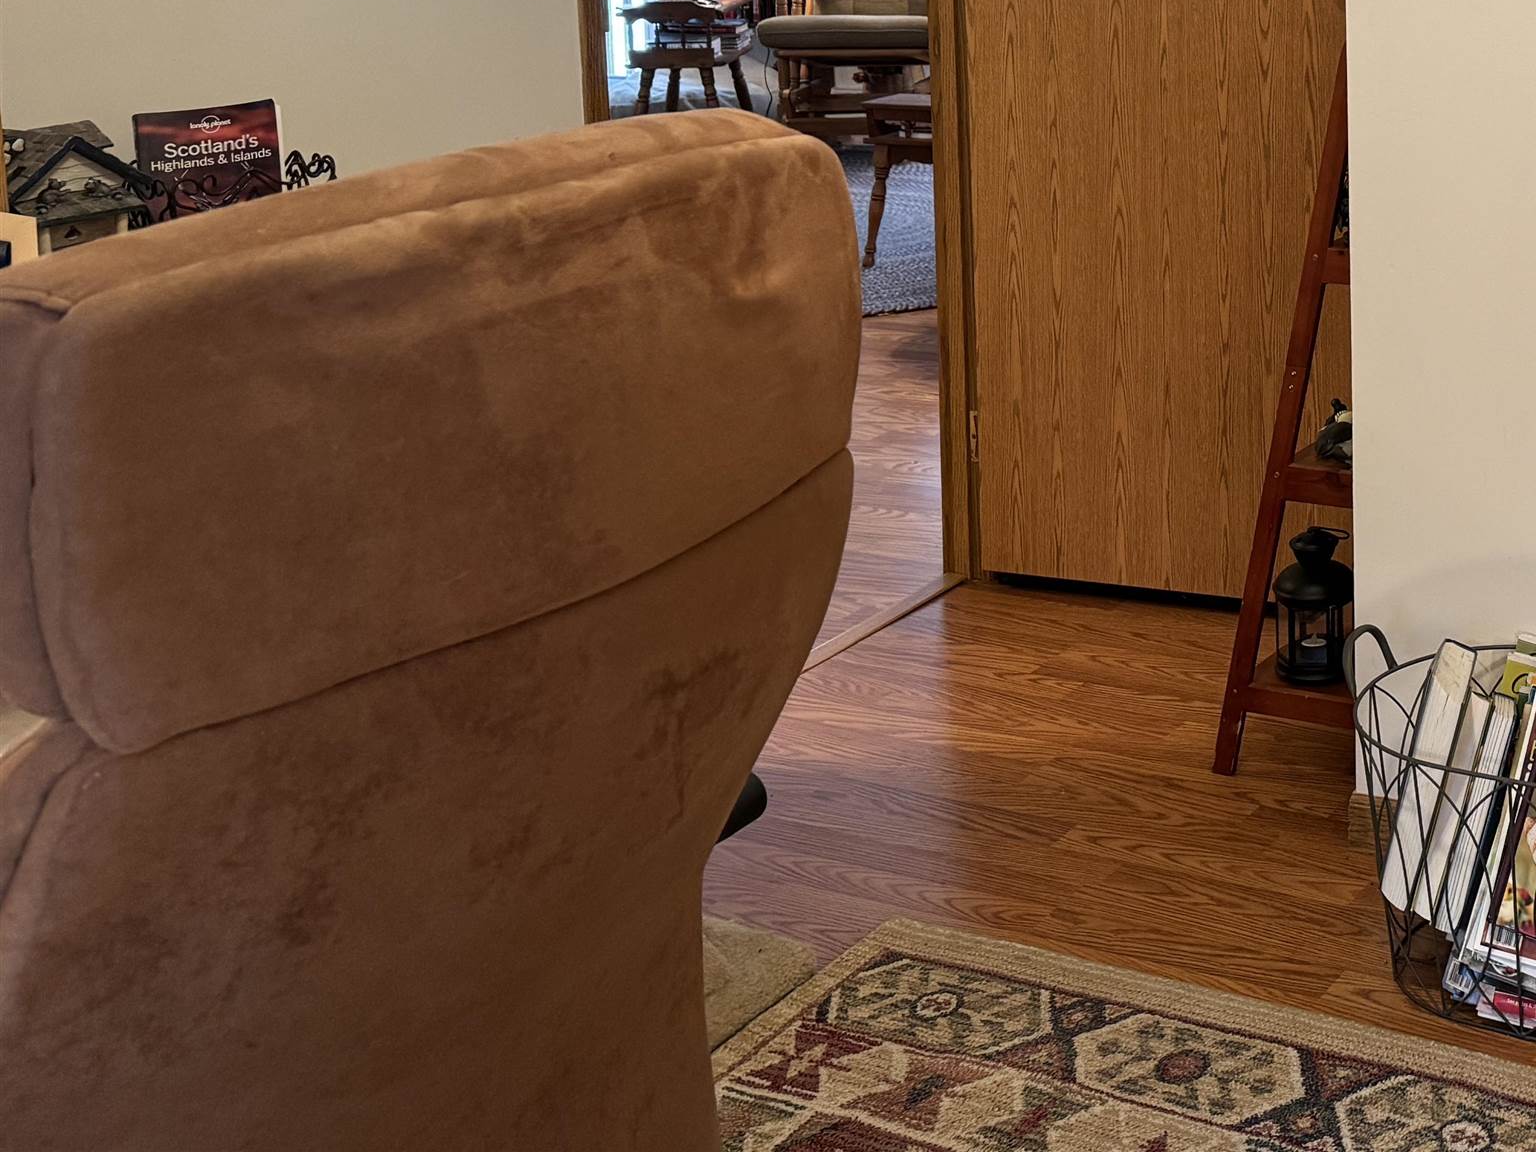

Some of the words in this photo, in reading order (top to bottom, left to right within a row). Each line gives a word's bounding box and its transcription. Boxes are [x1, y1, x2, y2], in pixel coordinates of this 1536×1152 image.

[190, 121, 210, 129] lonely
[210, 118, 231, 128] planet
[164, 134, 259, 158] Scotland's
[150, 156, 215, 172] Highlands
[217, 154, 228, 164] &
[231, 148, 272, 162] Islands
